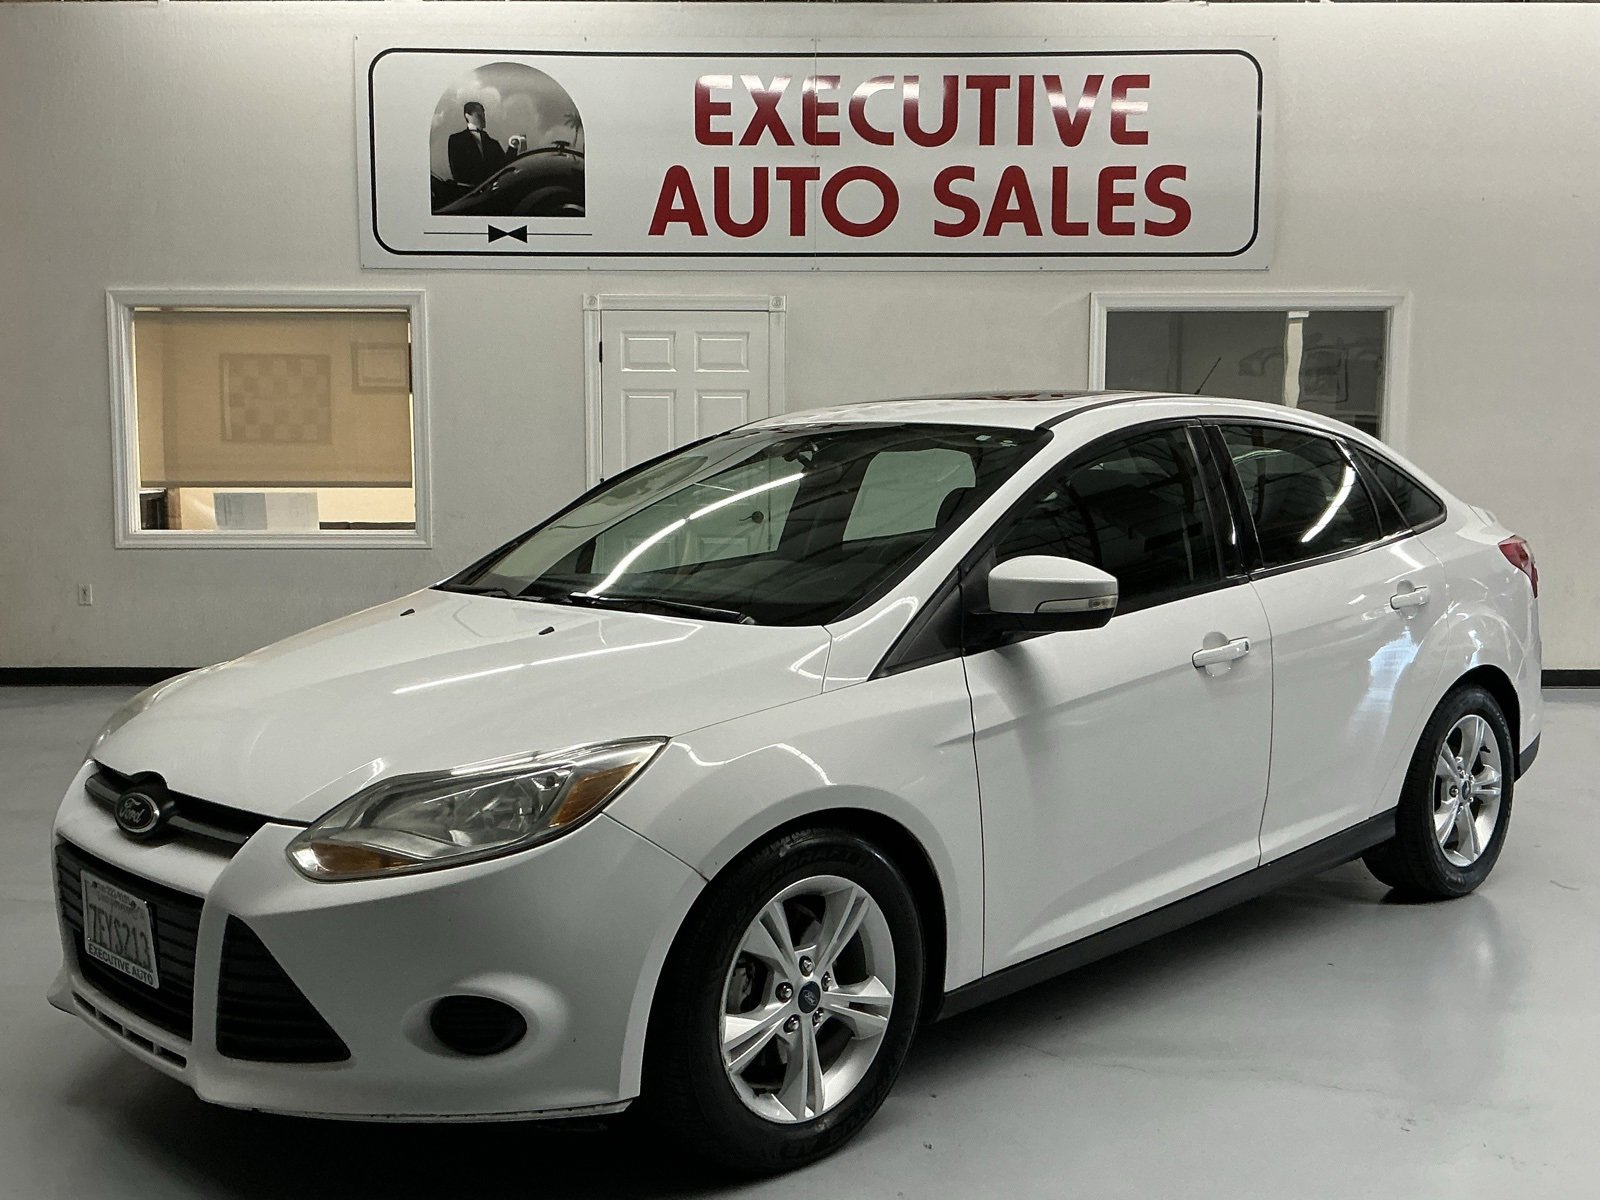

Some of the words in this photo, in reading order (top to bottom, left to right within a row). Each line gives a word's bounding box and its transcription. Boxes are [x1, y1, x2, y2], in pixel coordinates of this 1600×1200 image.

[695, 74, 1150, 146] EXECUTIVE
[650, 166, 899, 238] AUTO
[934, 165, 1191, 238] SALES
[119, 797, 145, 824] Ford
[88, 942, 131, 974] EXECUTIVE
[131, 966, 154, 986] AUTO
